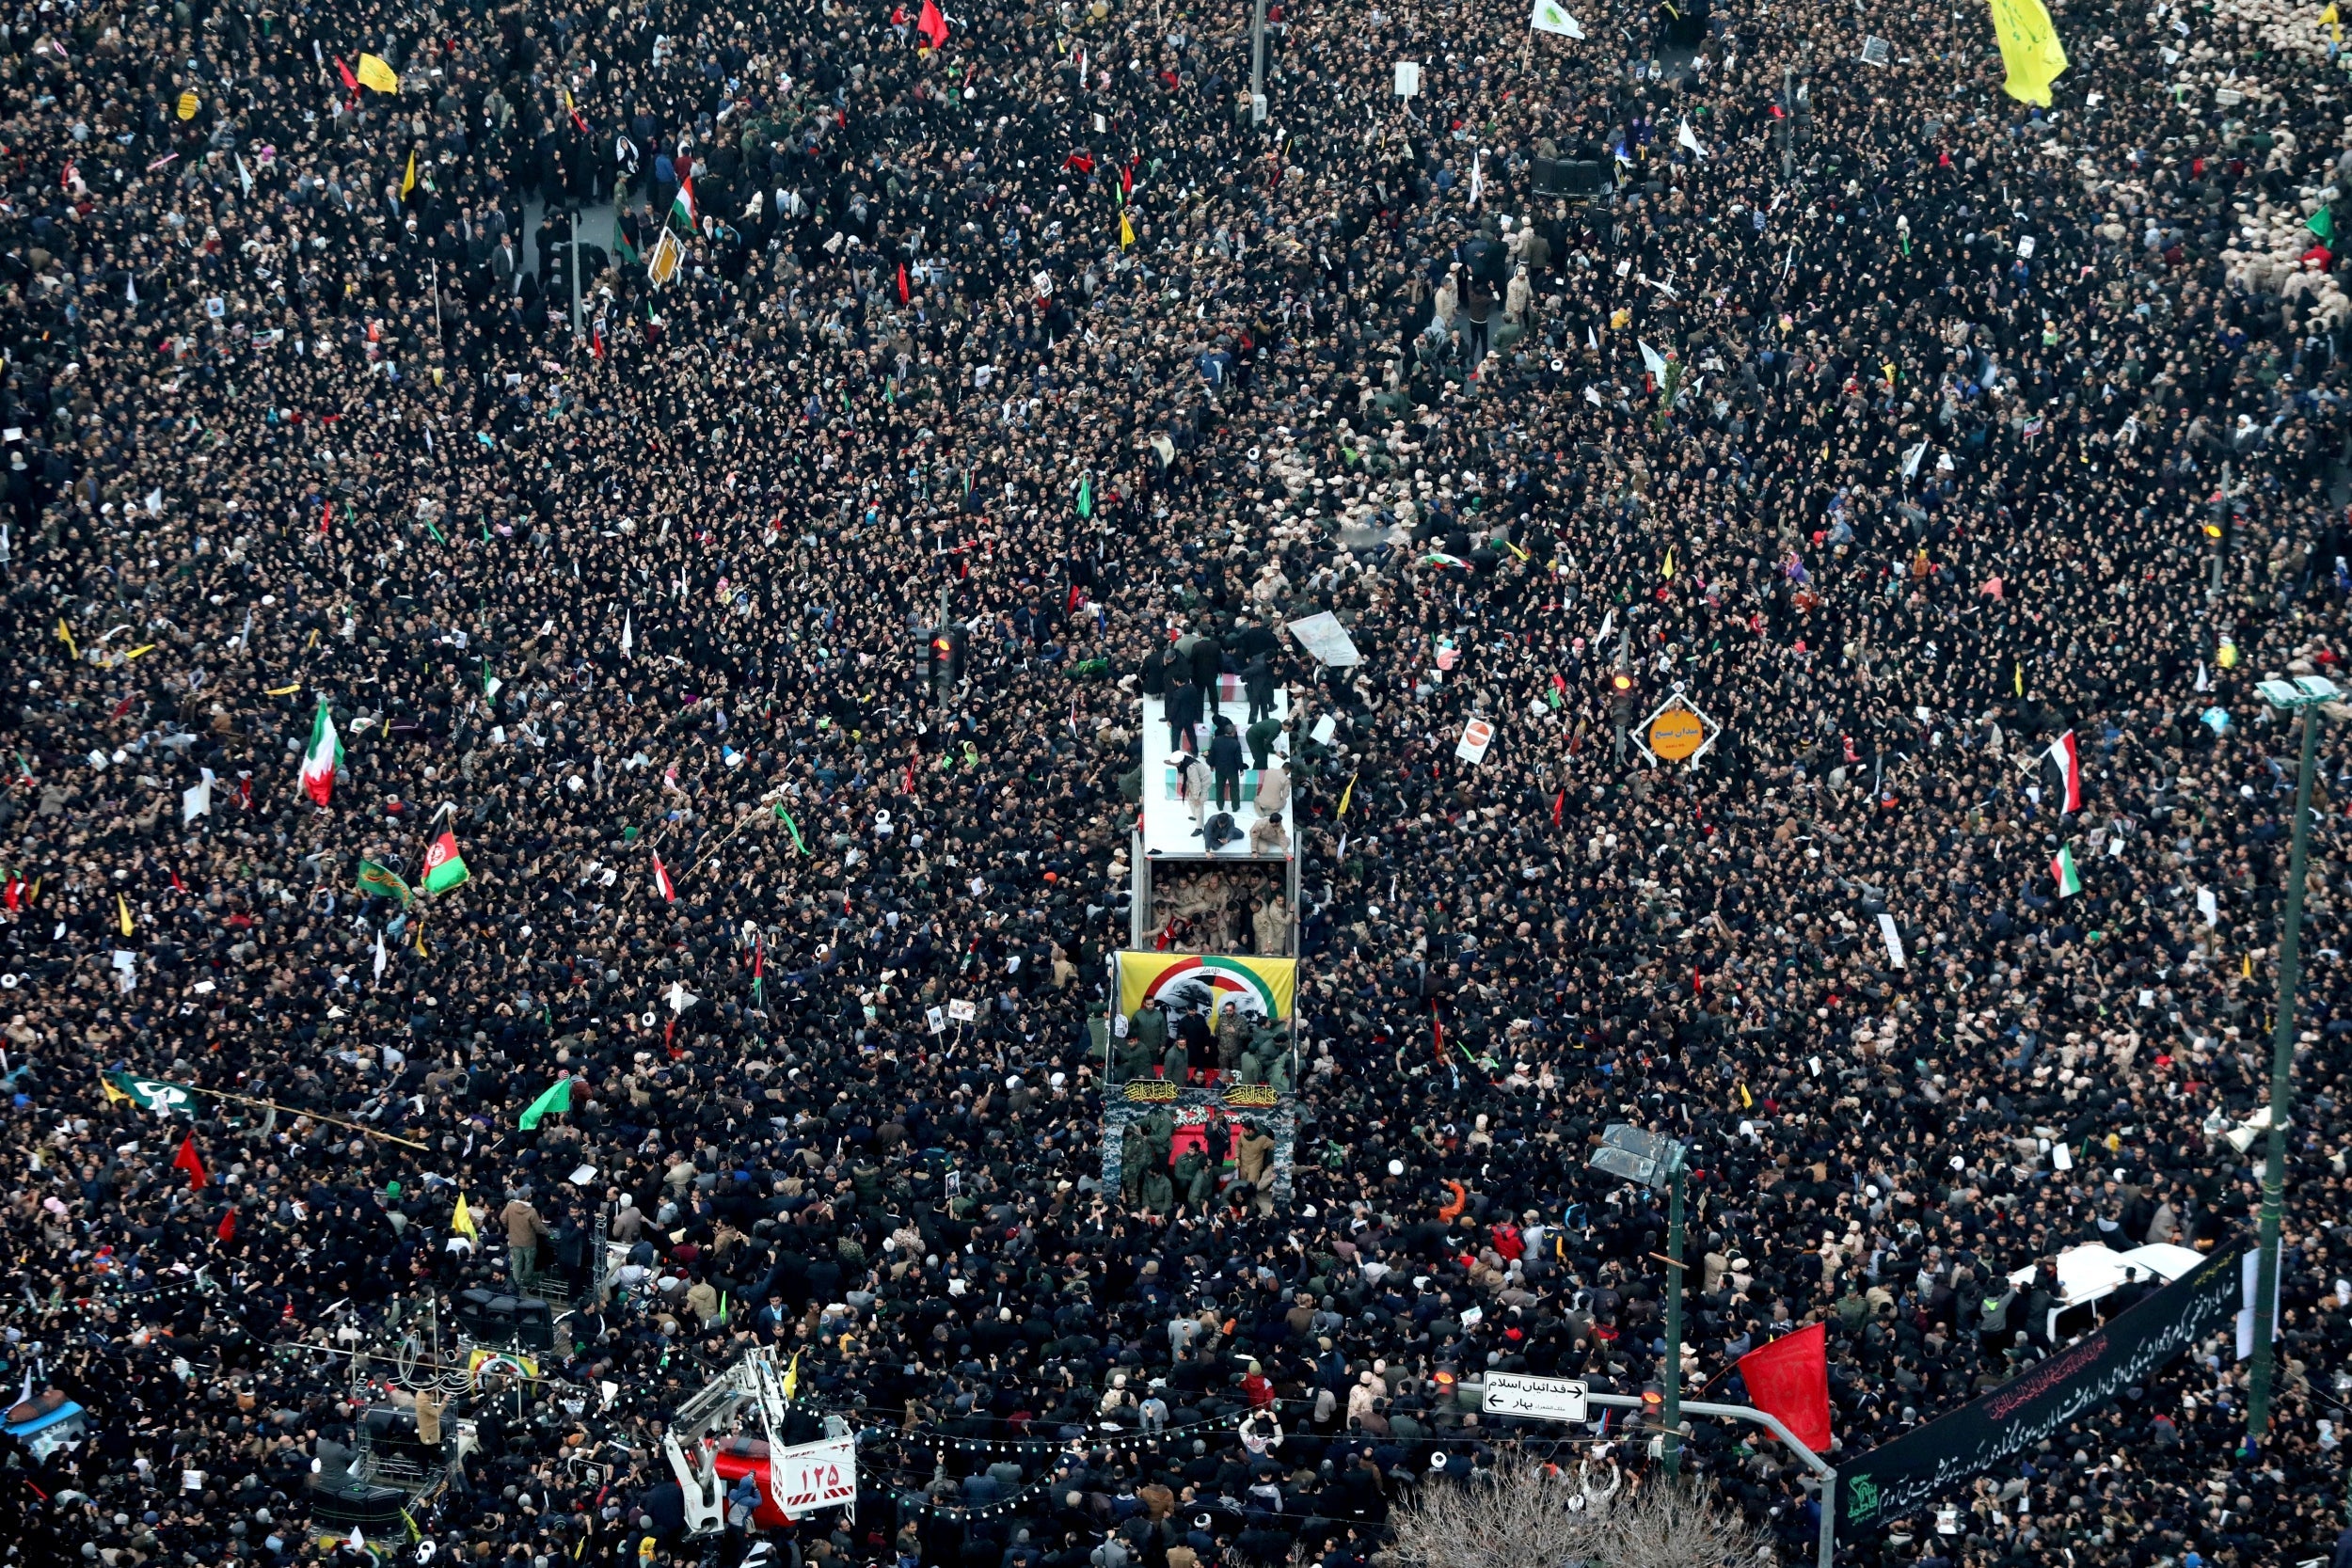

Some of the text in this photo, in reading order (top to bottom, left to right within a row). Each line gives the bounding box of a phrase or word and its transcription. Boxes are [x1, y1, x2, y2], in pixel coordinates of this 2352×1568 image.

[1655, 727, 1698, 740] میدان بسیج
[1488, 1379, 1520, 1390] اسلام
[1513, 1399, 1534, 1410] بهار
[802, 1464, 839, 1491] ۱۲۵
